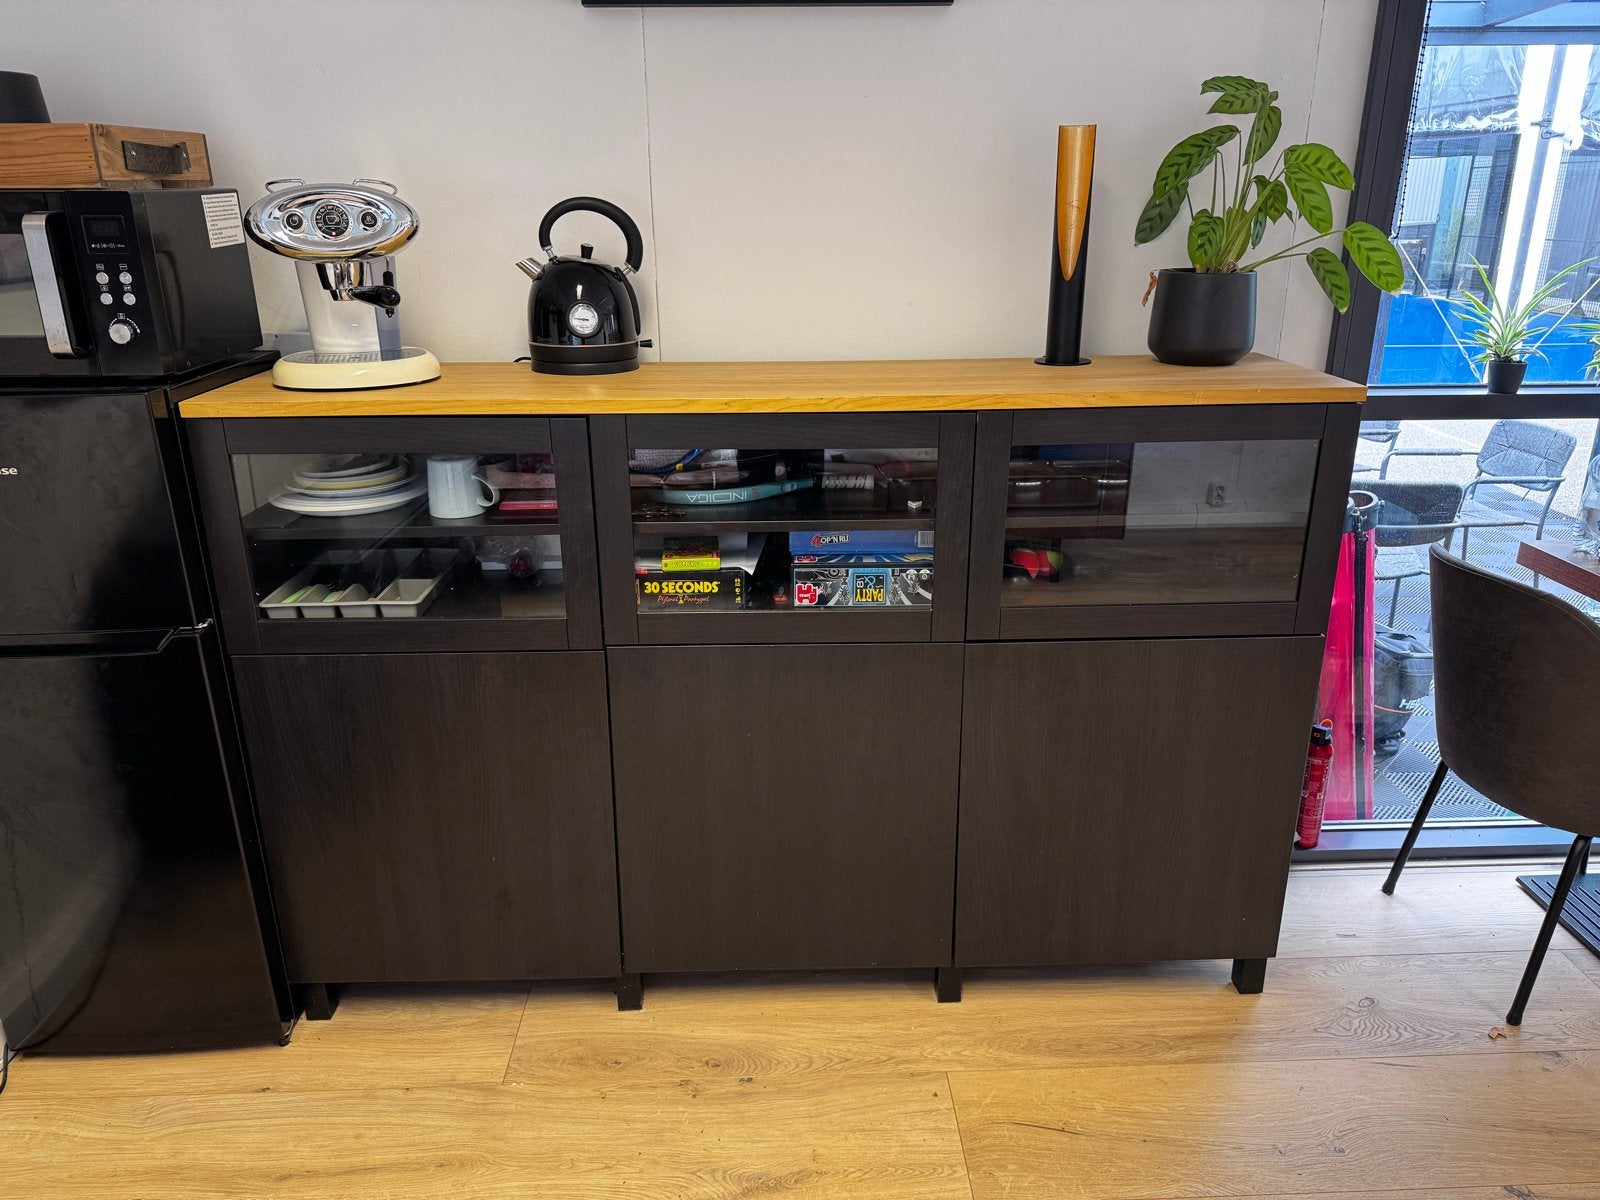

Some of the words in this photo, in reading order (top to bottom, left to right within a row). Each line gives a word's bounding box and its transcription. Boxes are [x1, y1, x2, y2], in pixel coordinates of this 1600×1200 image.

[0, 467, 18, 475] se
[644, 581, 660, 594] 30
[661, 581, 719, 594] SECONDS
[863, 575, 876, 590] &
[856, 588, 883, 602] PARTY
